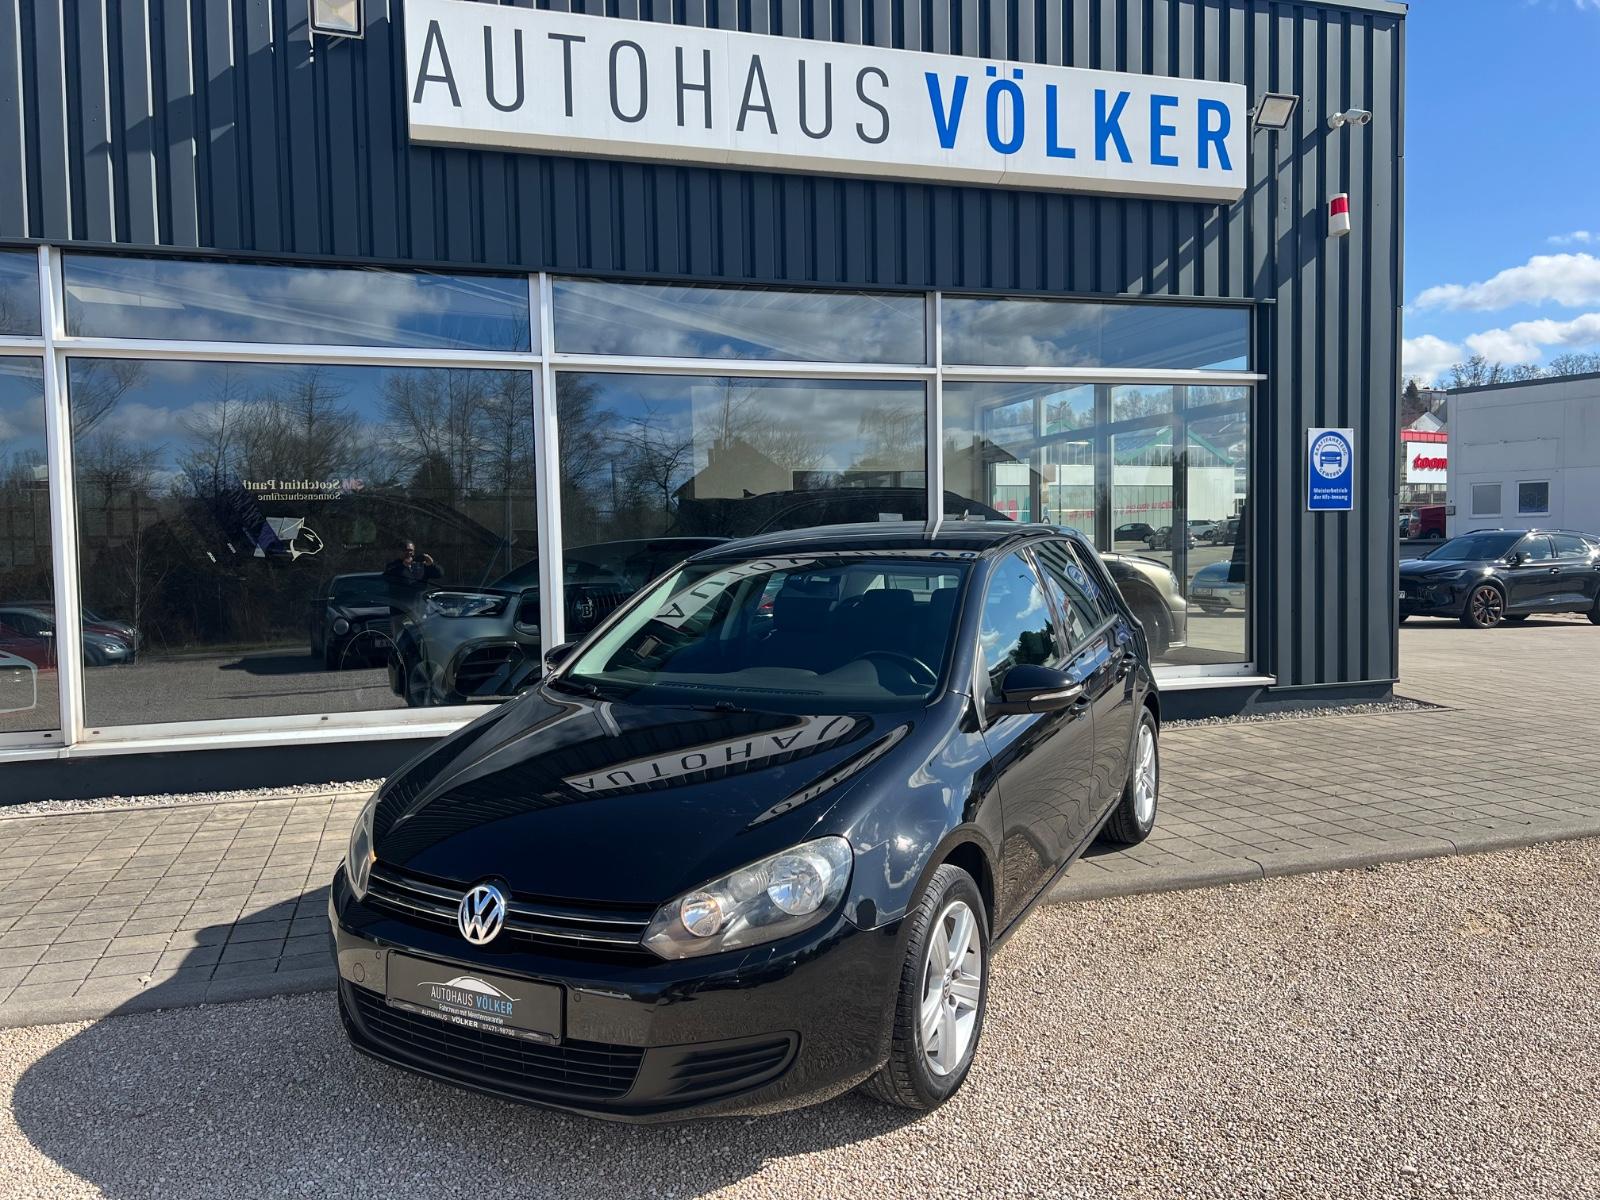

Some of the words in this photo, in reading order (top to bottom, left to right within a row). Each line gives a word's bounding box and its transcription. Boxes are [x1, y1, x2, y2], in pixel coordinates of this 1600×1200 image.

[413, 19, 890, 144] AUTOHAUS
[925, 65, 1234, 172] VÖLKER
[430, 985, 474, 1007] AUTOHAUS
[475, 994, 513, 1015] VÖLKER
